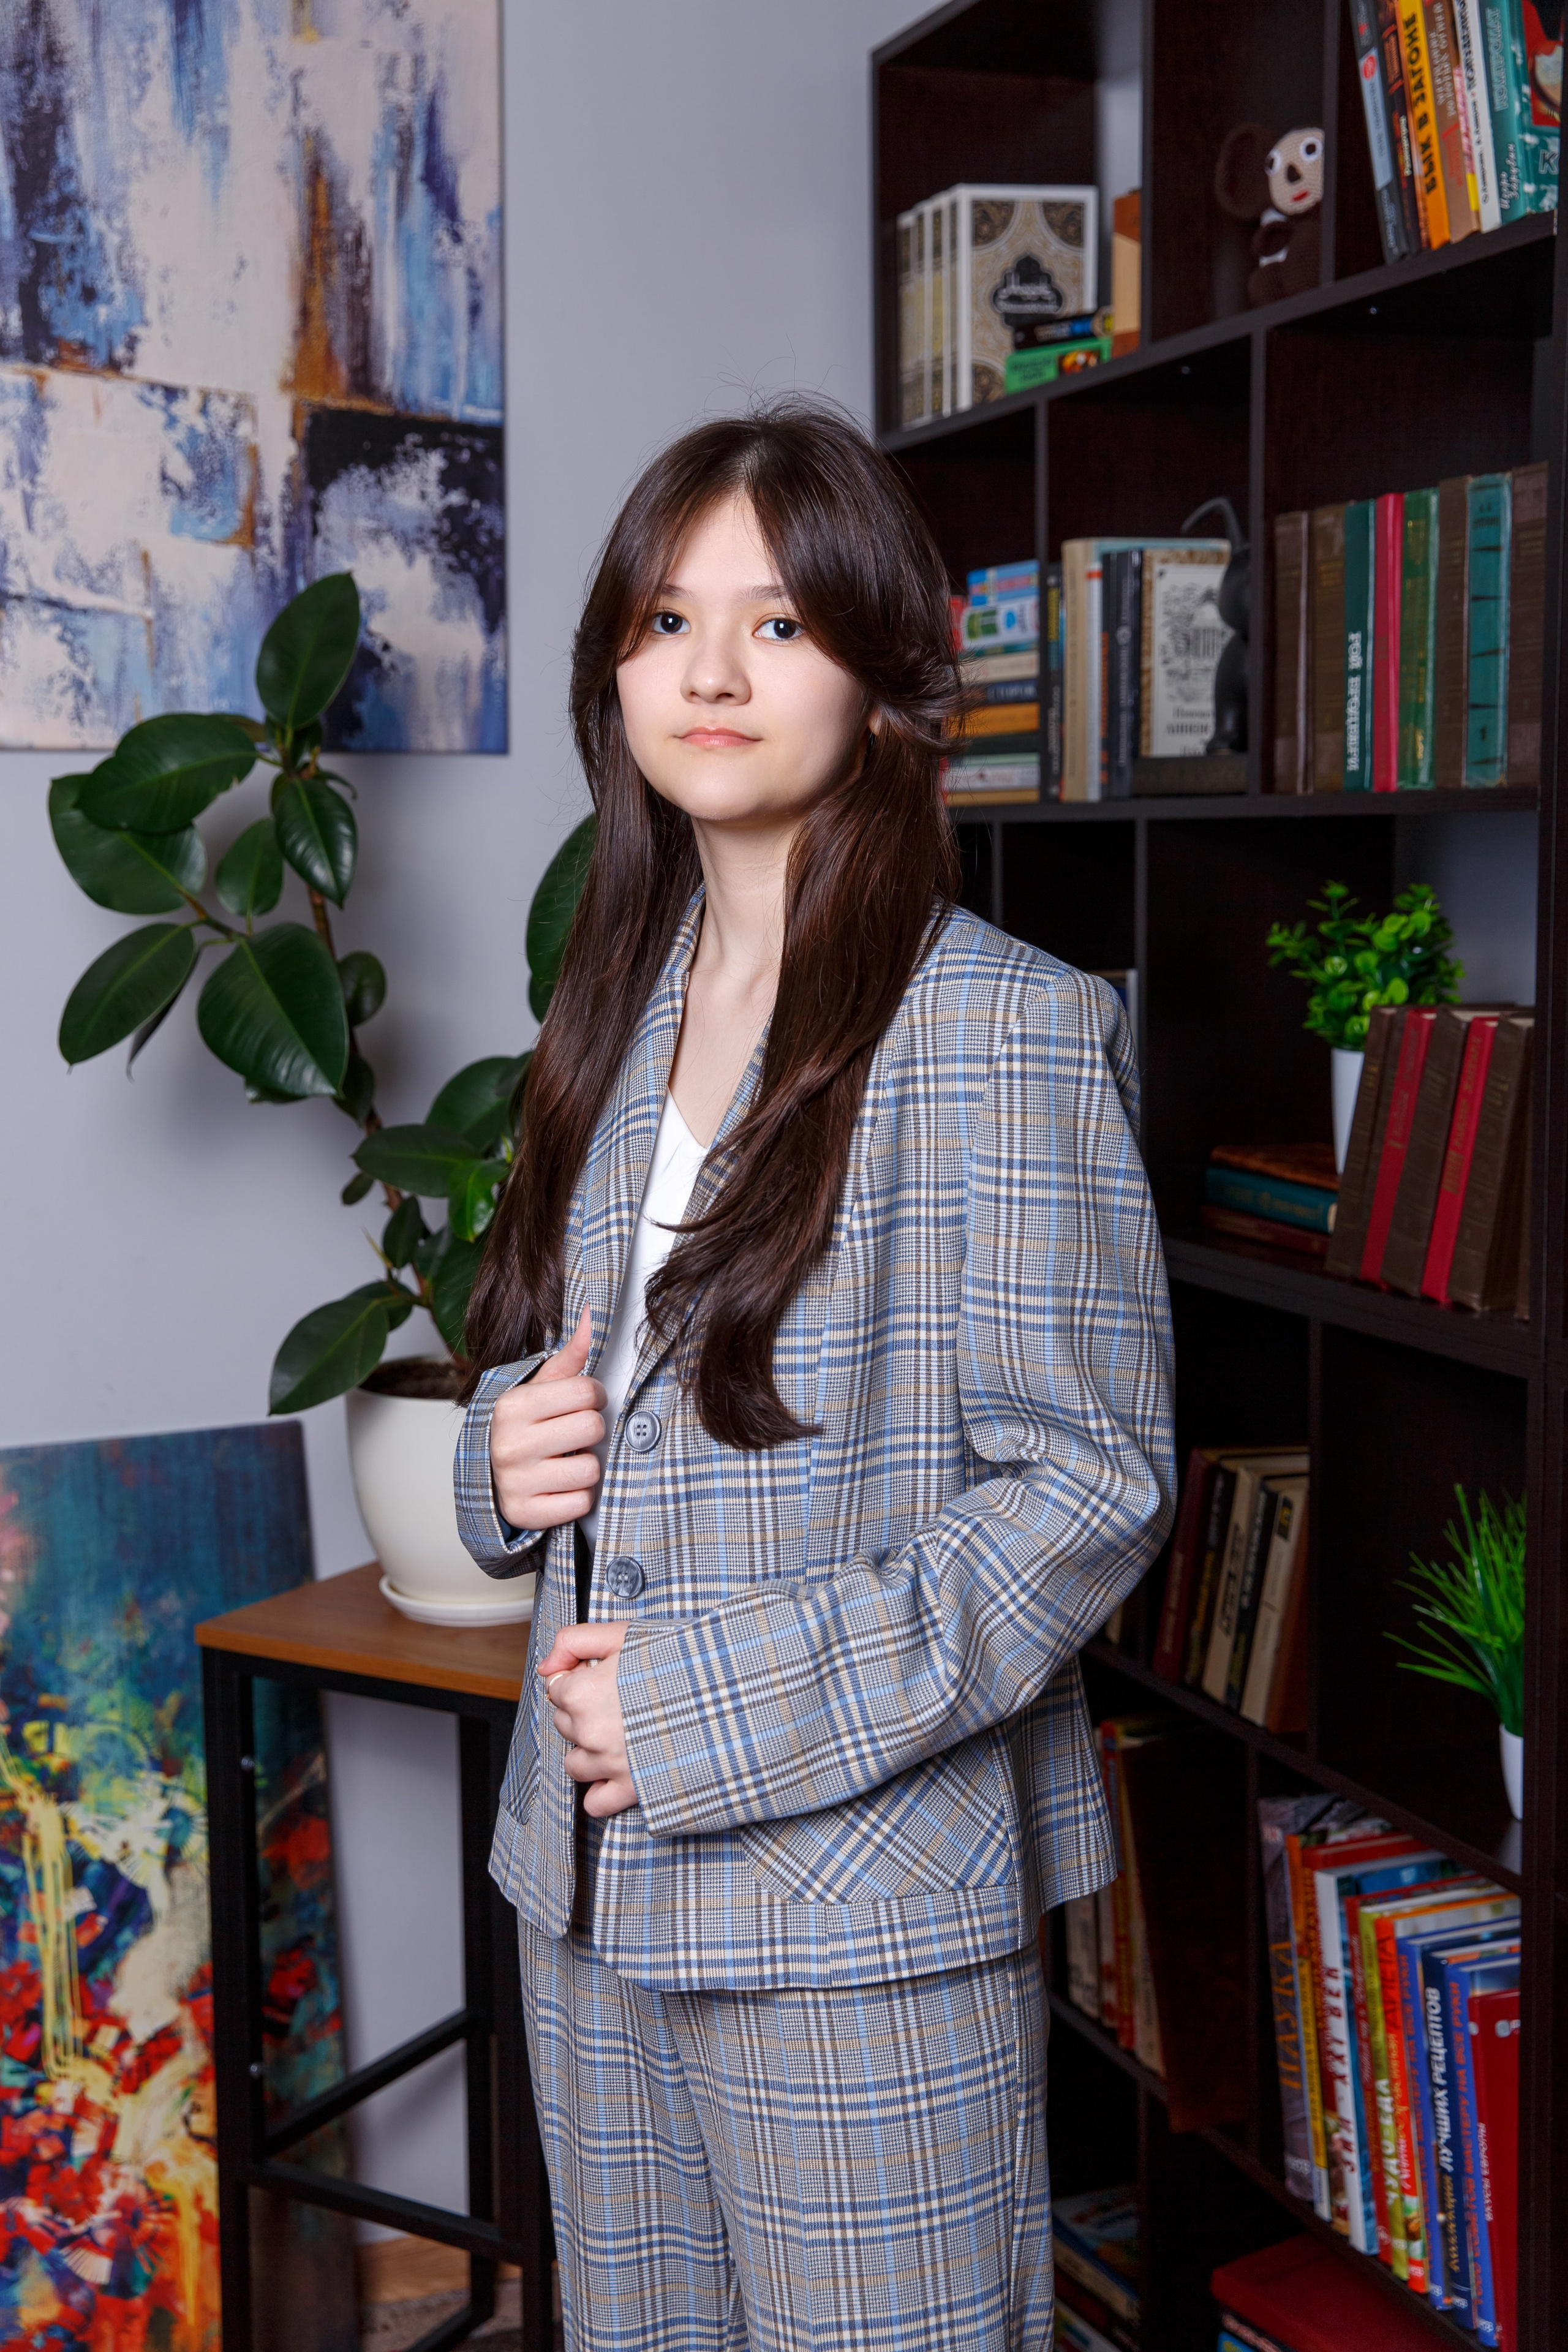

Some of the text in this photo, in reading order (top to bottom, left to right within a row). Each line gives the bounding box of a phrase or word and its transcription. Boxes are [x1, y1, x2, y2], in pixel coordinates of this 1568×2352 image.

[1403, 12, 1426, 108] ЗАГОНЕ
[1485, 7, 1509, 112] КОМПРОМАТ
[1417, 113, 1430, 130] В
[1419, 134, 1437, 195] БЫК
[1499, 170, 1510, 210] Игорь
[1506, 143, 1520, 201] Зарубин
[1425, 1986, 1448, 2084] РЕЦЕПТОВ
[1376, 2078, 1400, 2204] ЧУДО-ЕДА
[1433, 2087, 1454, 2172] ЛУЧШИХ
[1477, 2122, 1493, 2222] ВКУСЫ ЕВРОПЫ
